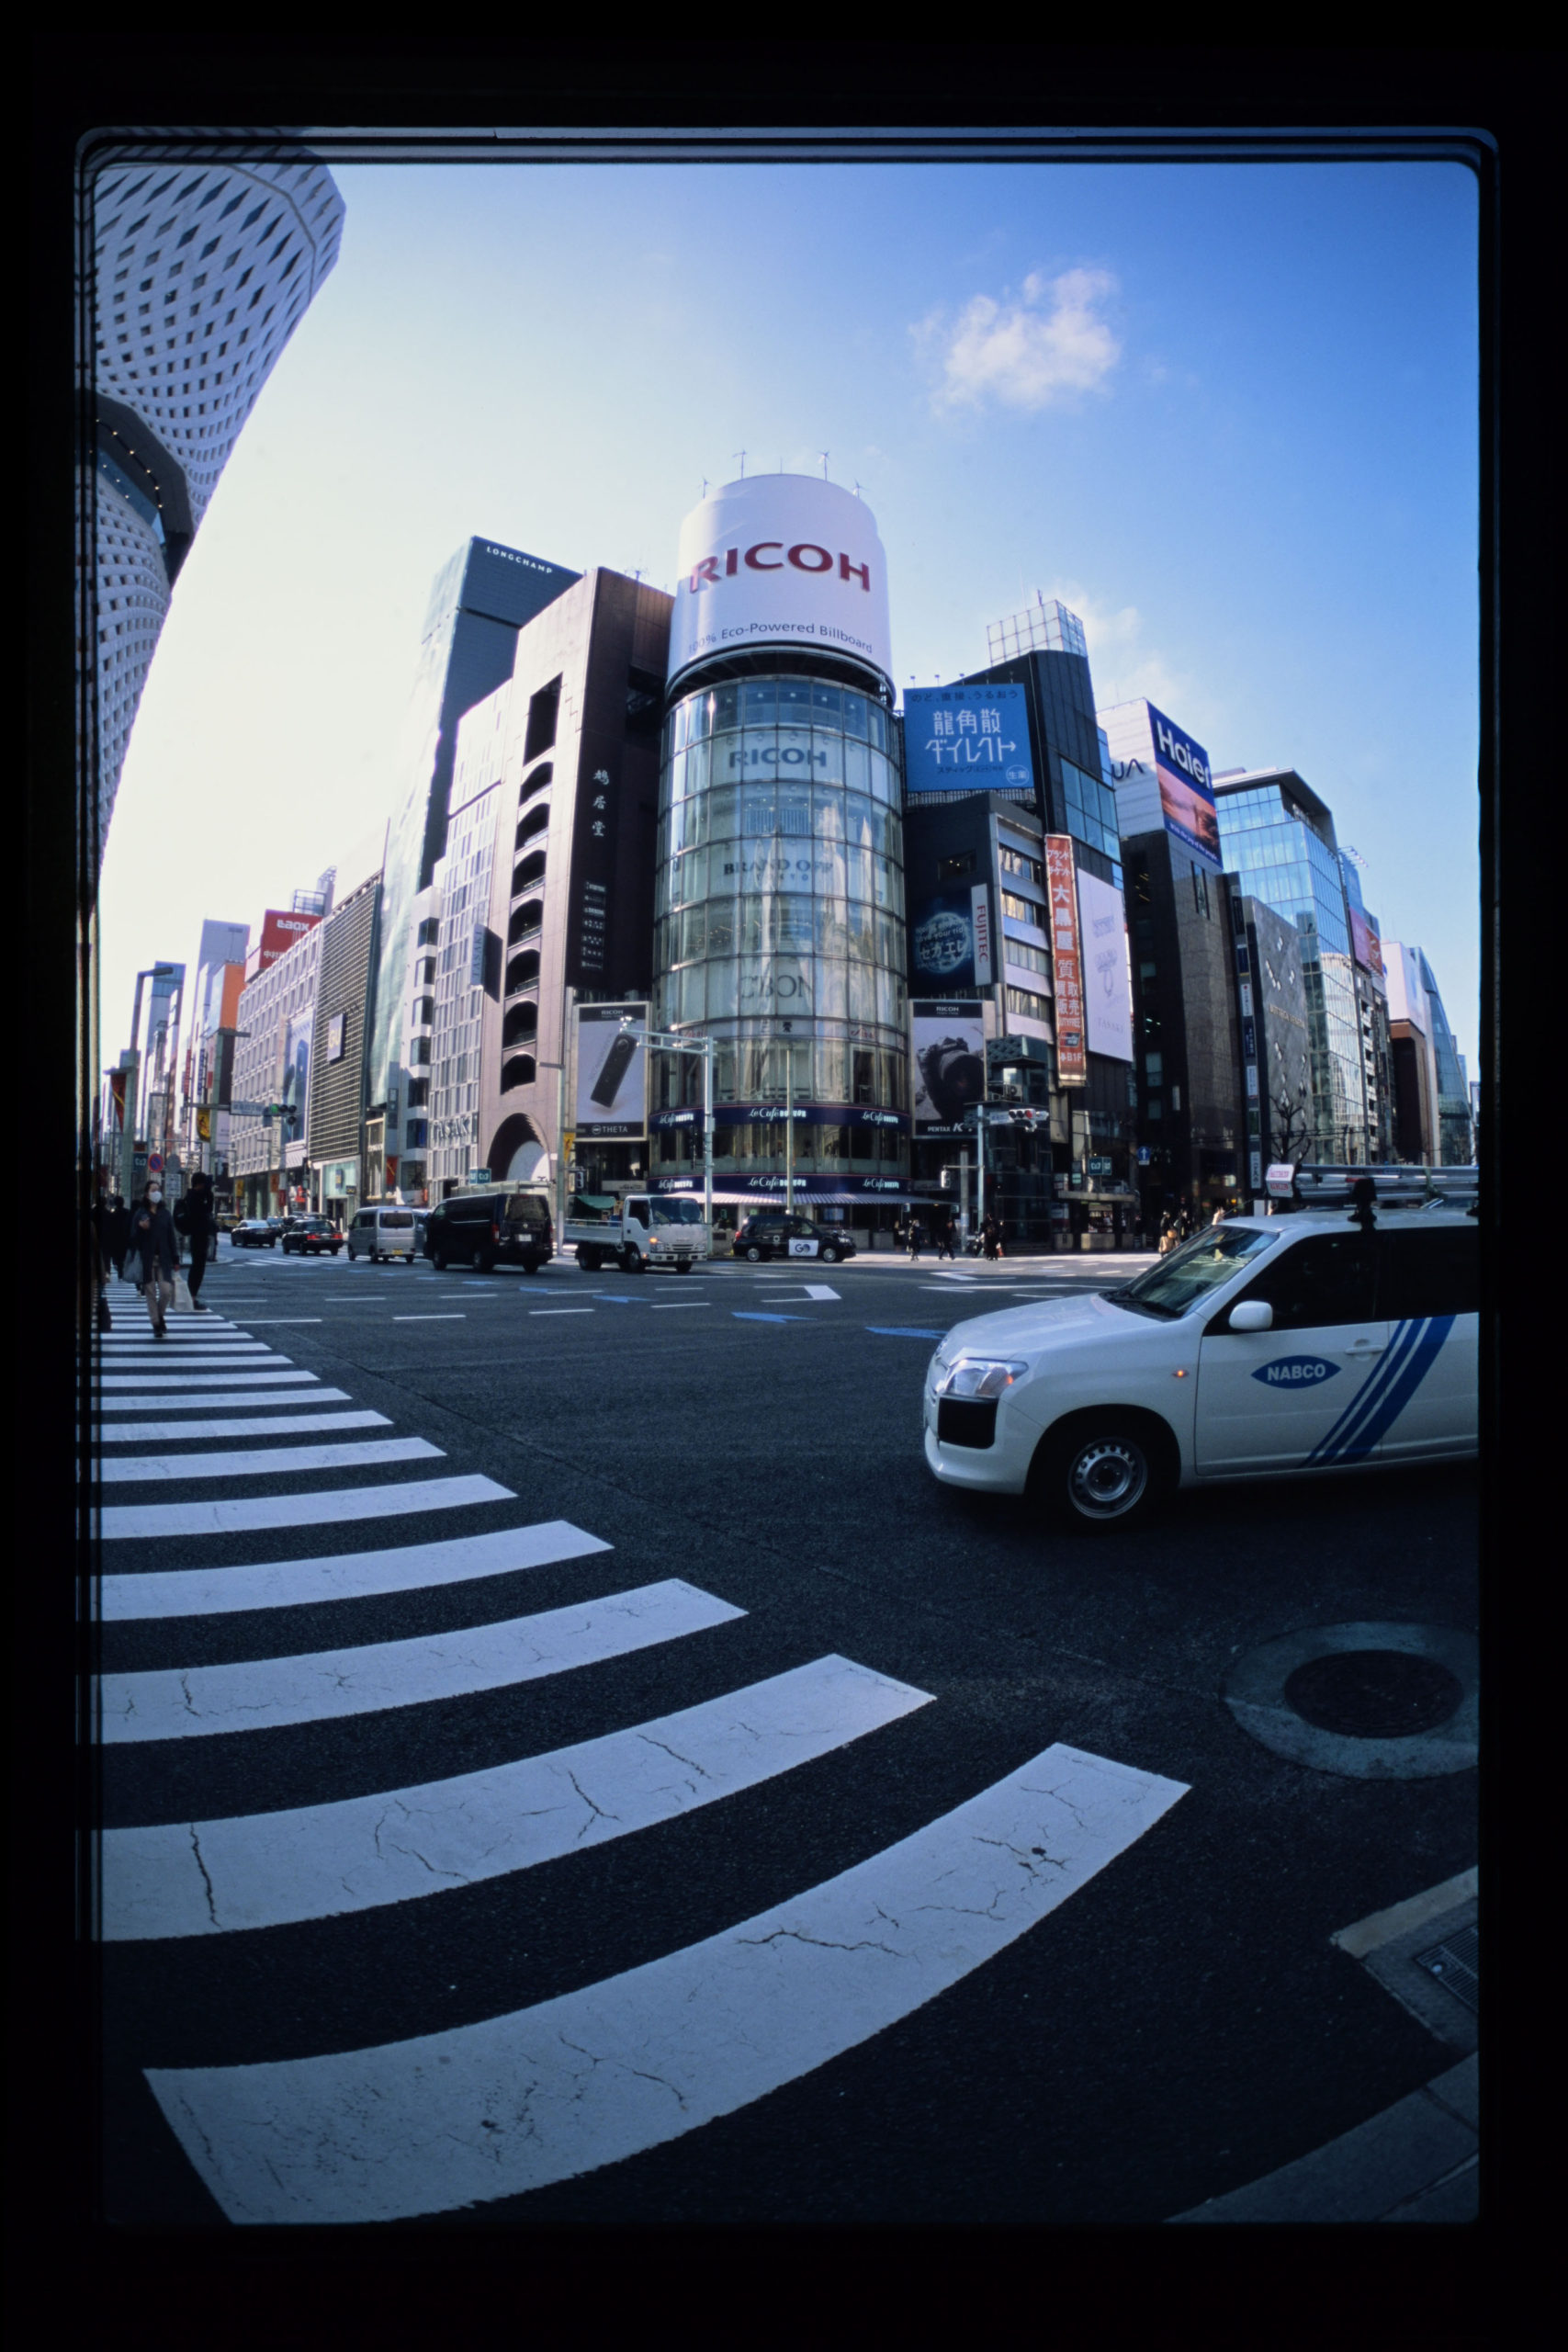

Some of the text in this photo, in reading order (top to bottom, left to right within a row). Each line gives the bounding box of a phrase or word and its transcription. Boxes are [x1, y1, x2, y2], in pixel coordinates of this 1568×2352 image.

[486, 546, 554, 573] LONGCHAMP
[690, 541, 871, 594] RICOH
[721, 622, 816, 640] Eco-Powered
[819, 625, 874, 654] Billboard
[933, 707, 1001, 736] 龍角散
[728, 747, 828, 768] RICOH
[924, 737, 1017, 764] ダイレクト
[1156, 719, 1211, 790] Haier
[976, 905, 988, 963] FUJITEC
[1057, 959, 1075, 979] 質
[603, 1125, 628, 1134] THETA
[795, 1243, 810, 1253] GO
[1268, 1363, 1326, 1381] NABCO
